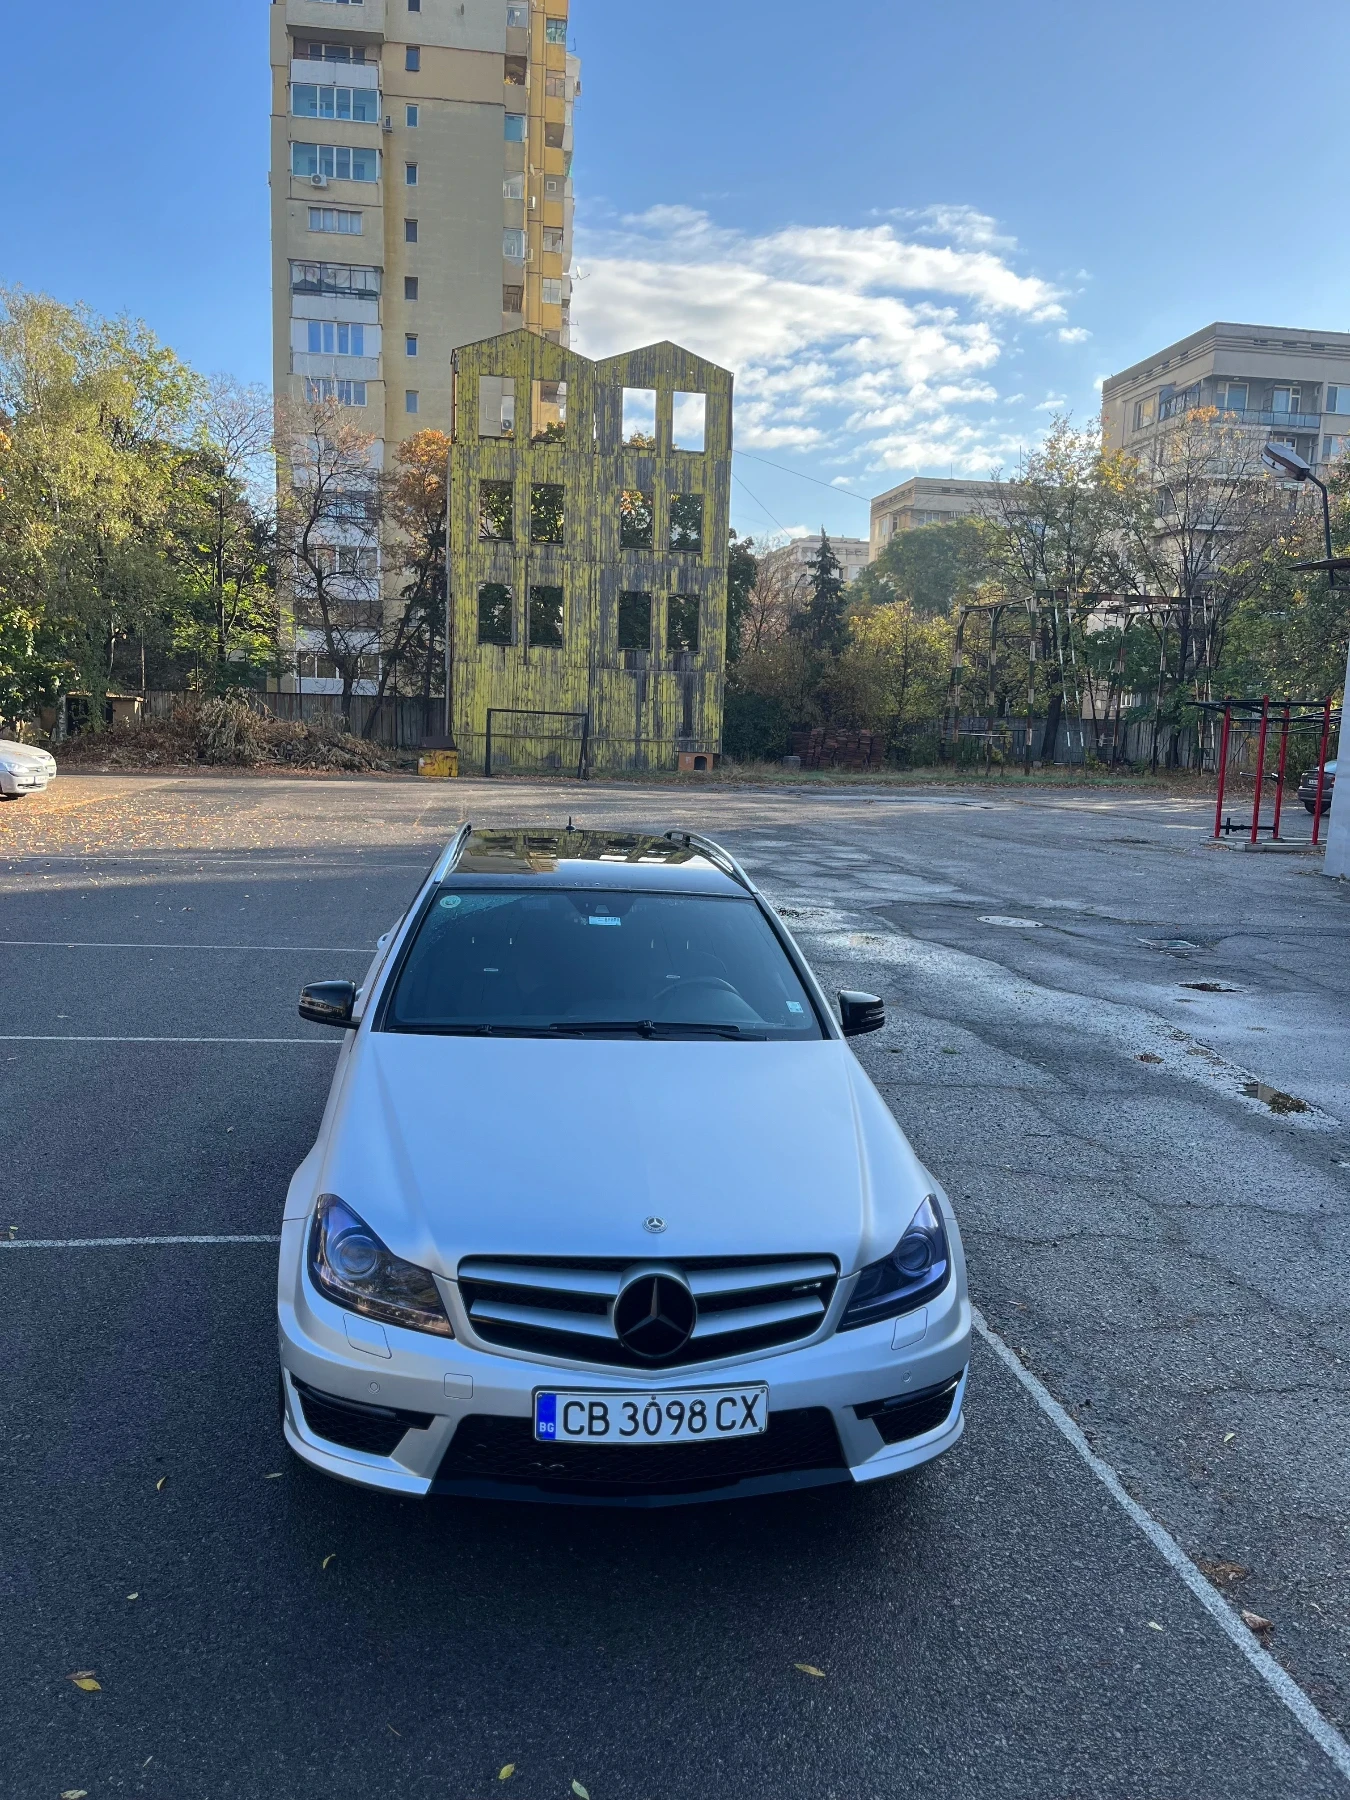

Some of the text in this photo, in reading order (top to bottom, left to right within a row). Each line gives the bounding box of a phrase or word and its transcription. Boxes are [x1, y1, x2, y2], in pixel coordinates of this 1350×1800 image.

[540, 1421, 555, 1433] BG
[563, 1393, 760, 1436] CB 3098 CX
